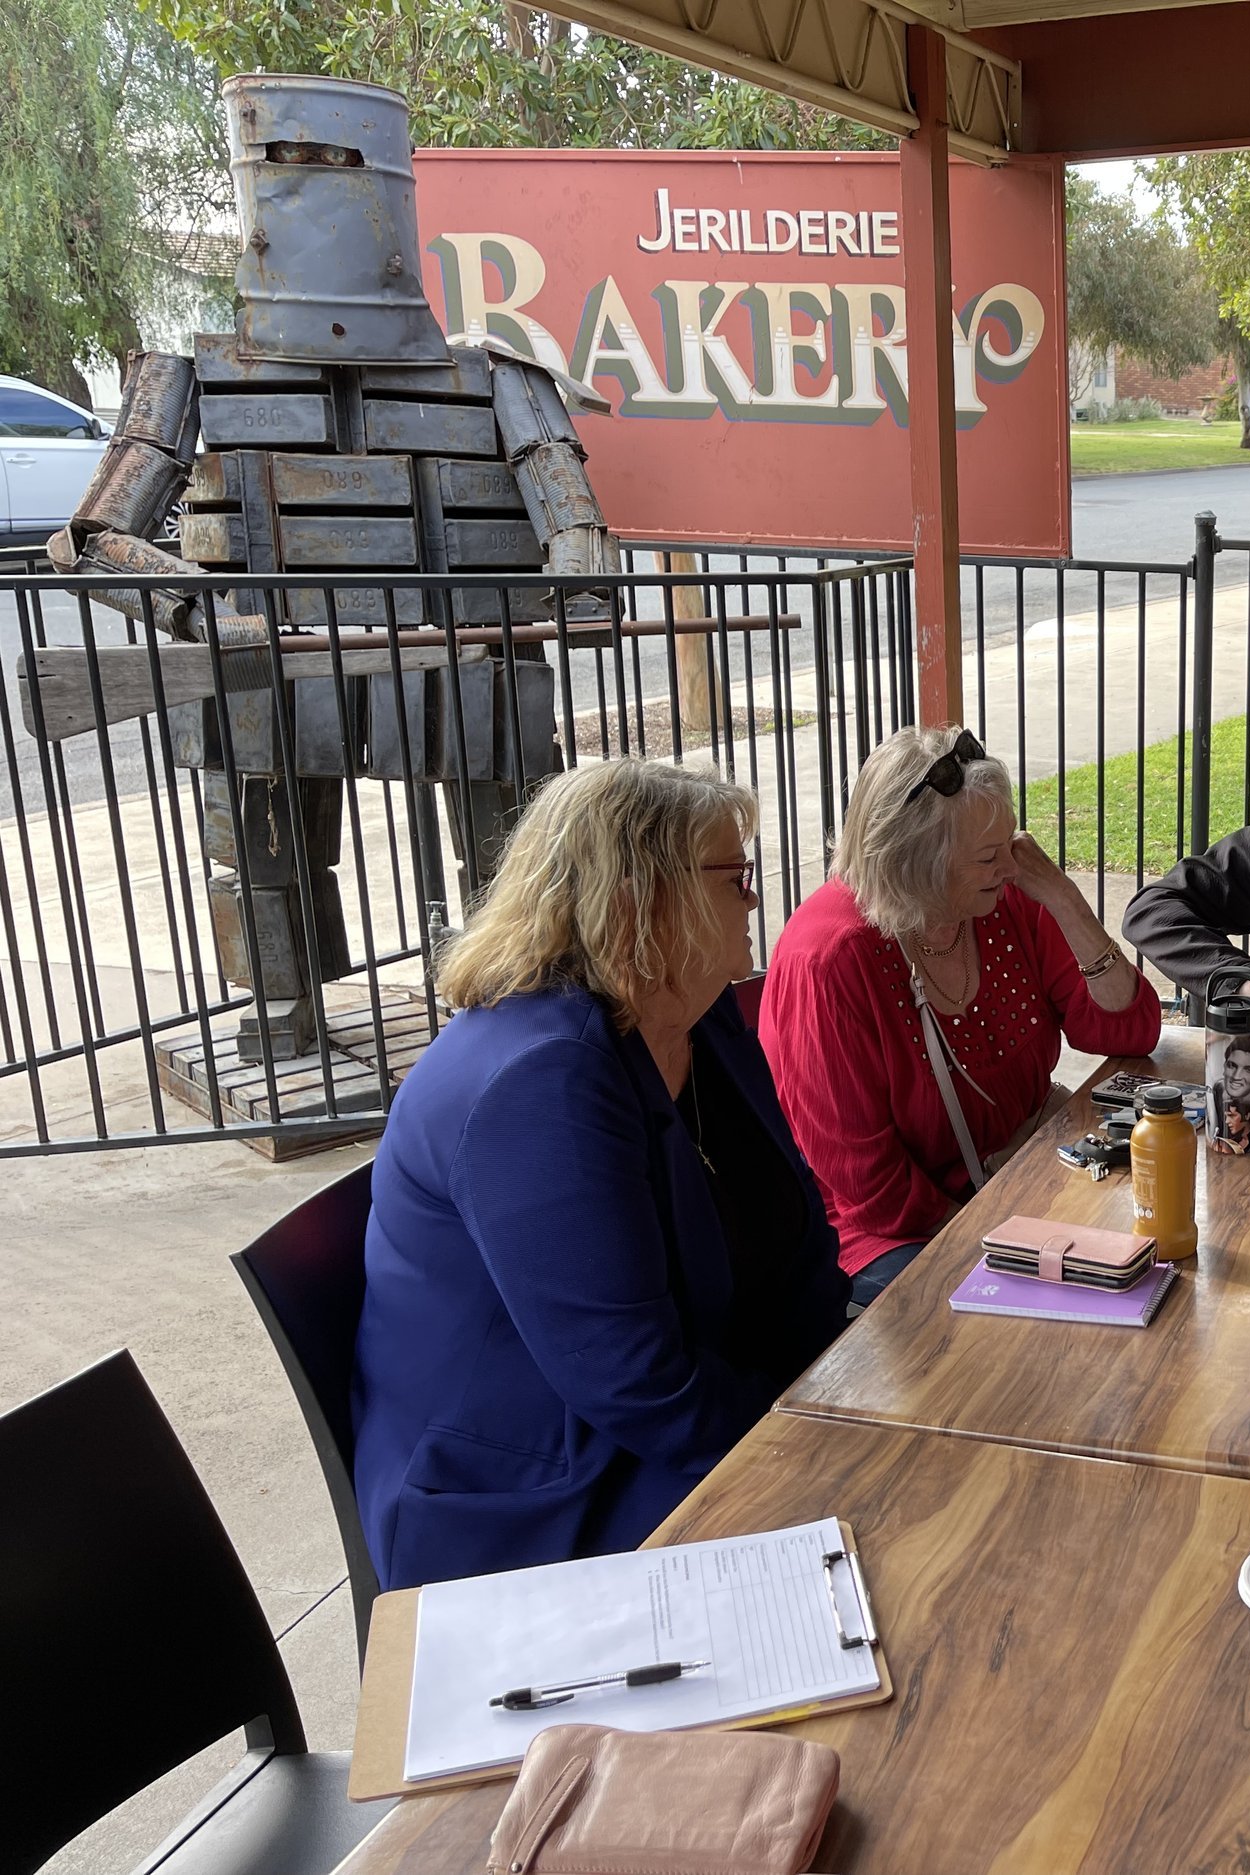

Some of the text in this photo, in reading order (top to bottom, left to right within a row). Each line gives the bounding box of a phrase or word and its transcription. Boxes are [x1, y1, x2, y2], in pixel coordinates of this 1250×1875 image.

[637, 187, 900, 256] JERILDERIE
[430, 232, 1046, 424] BAKERY
[322, 469, 363, 490] 089
[483, 474, 512, 495] 089
[489, 531, 518, 551] 089
